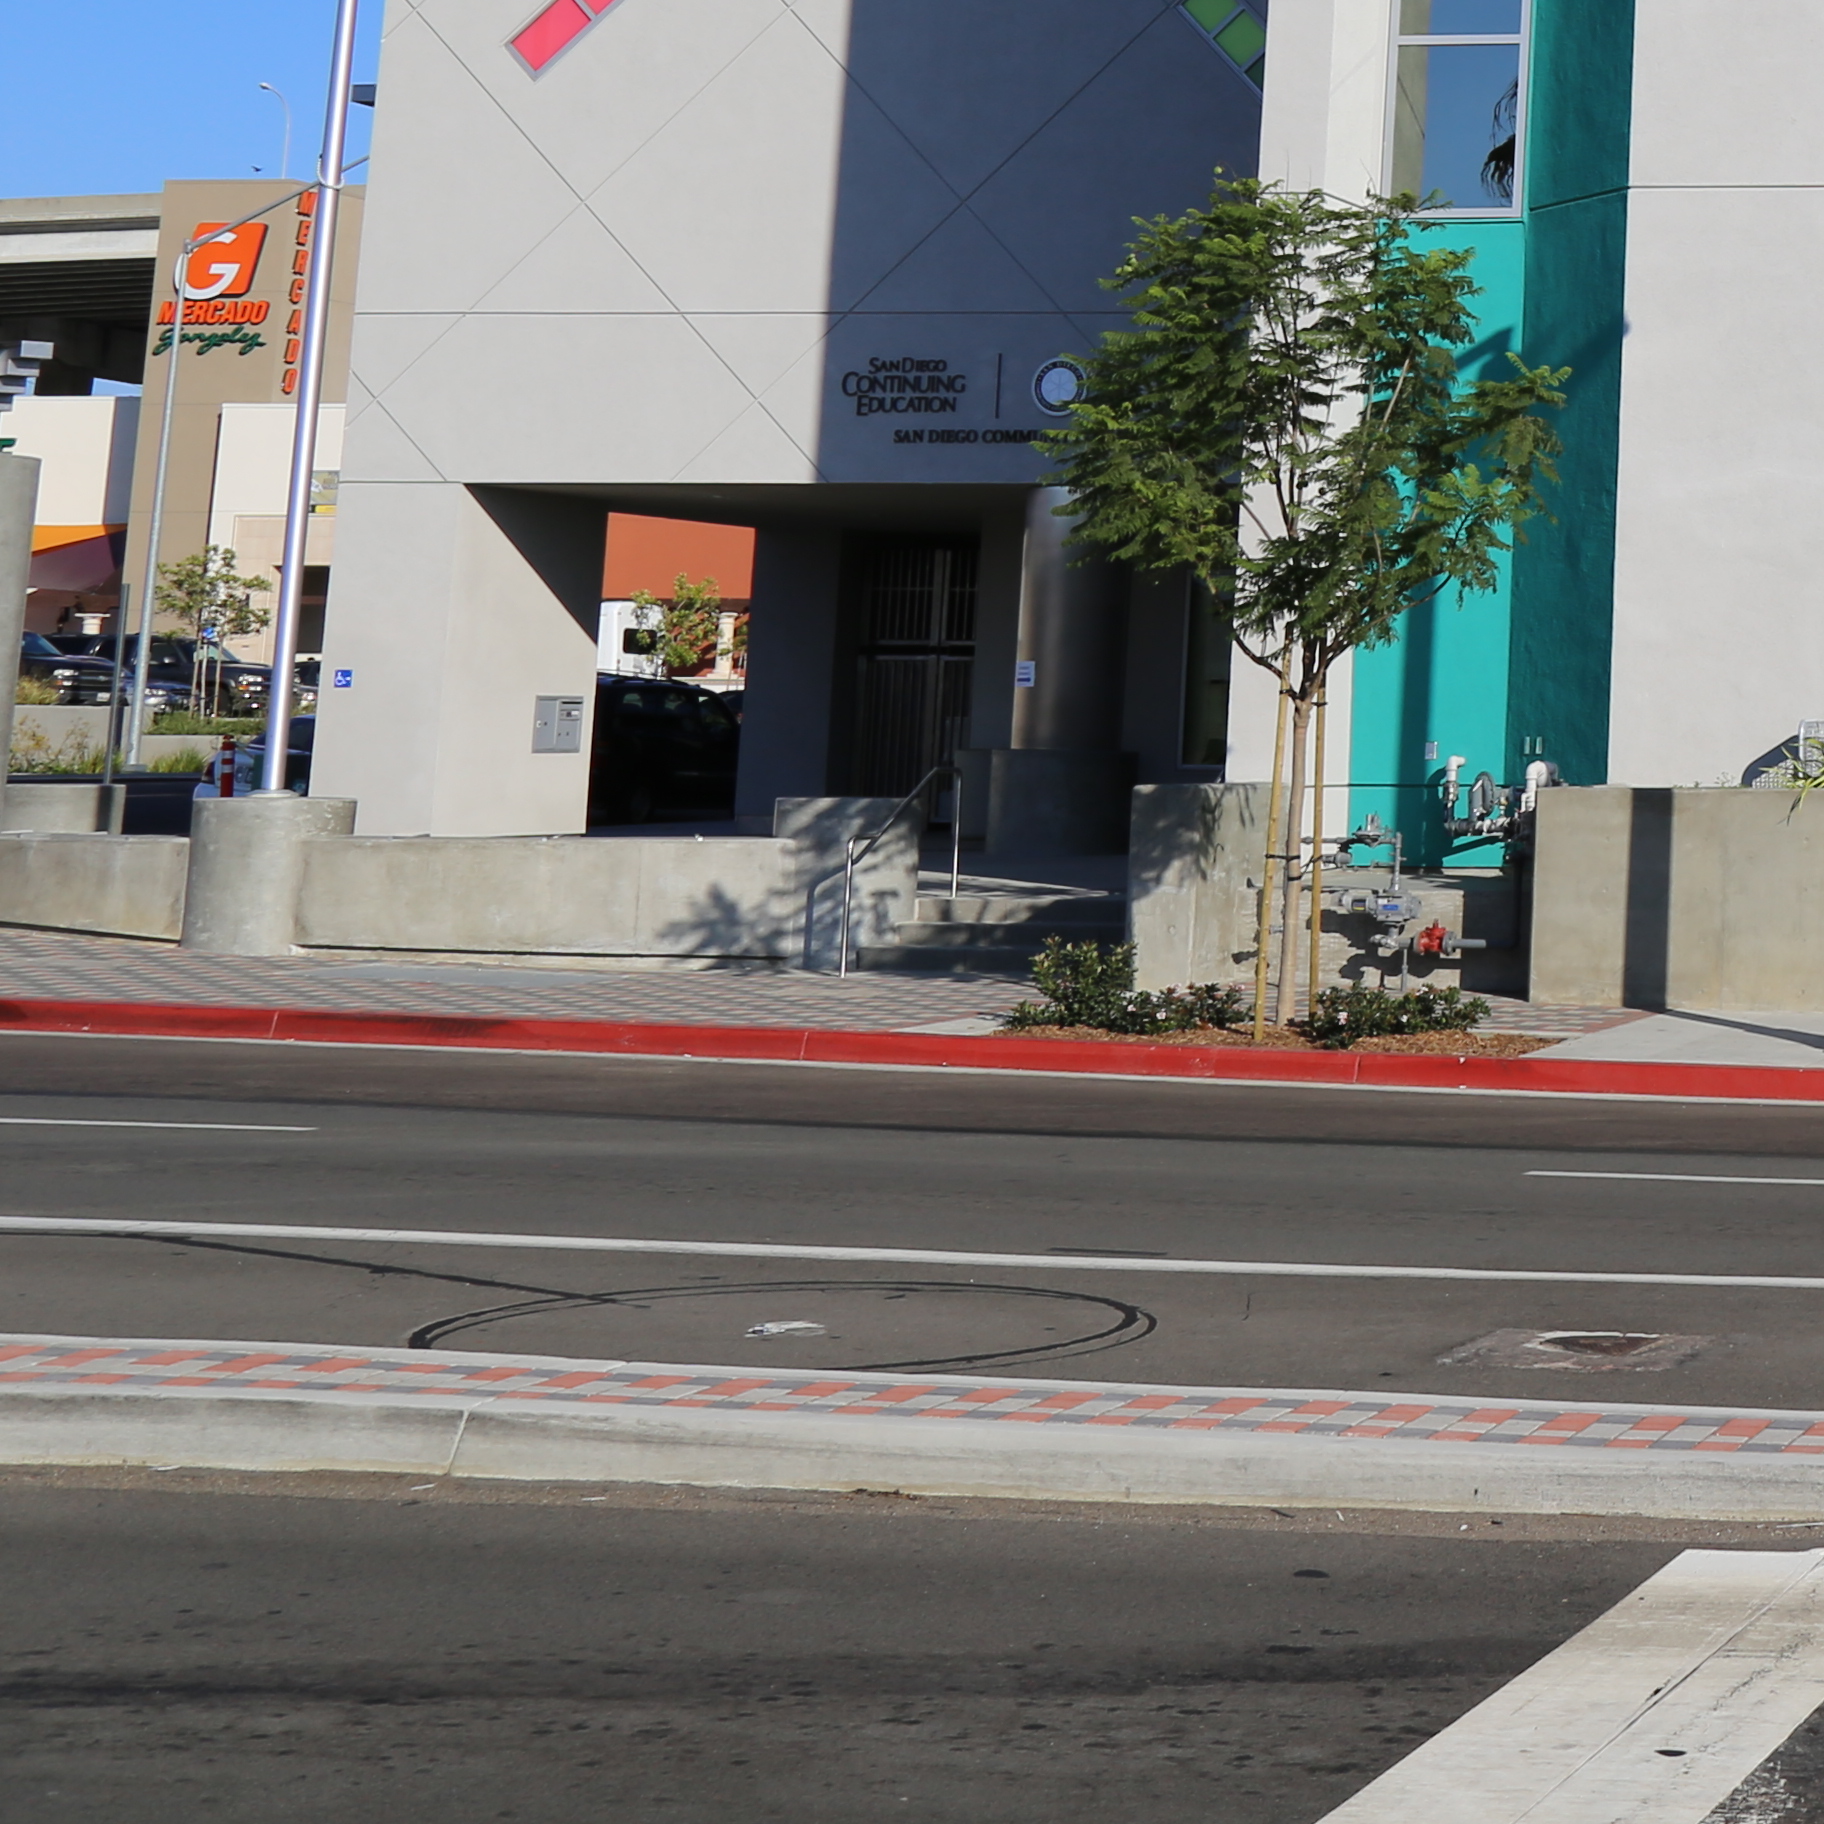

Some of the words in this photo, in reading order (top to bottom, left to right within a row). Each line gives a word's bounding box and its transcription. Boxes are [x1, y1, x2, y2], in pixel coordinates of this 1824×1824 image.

[282, 191, 318, 395] MERCADO
[156, 300, 270, 325] MERCADO
[841, 371, 966, 396] CONTINUING
[856, 394, 957, 416] EDUCATION
[893, 429, 927, 444] SAN
[928, 429, 978, 444] DIEGO
